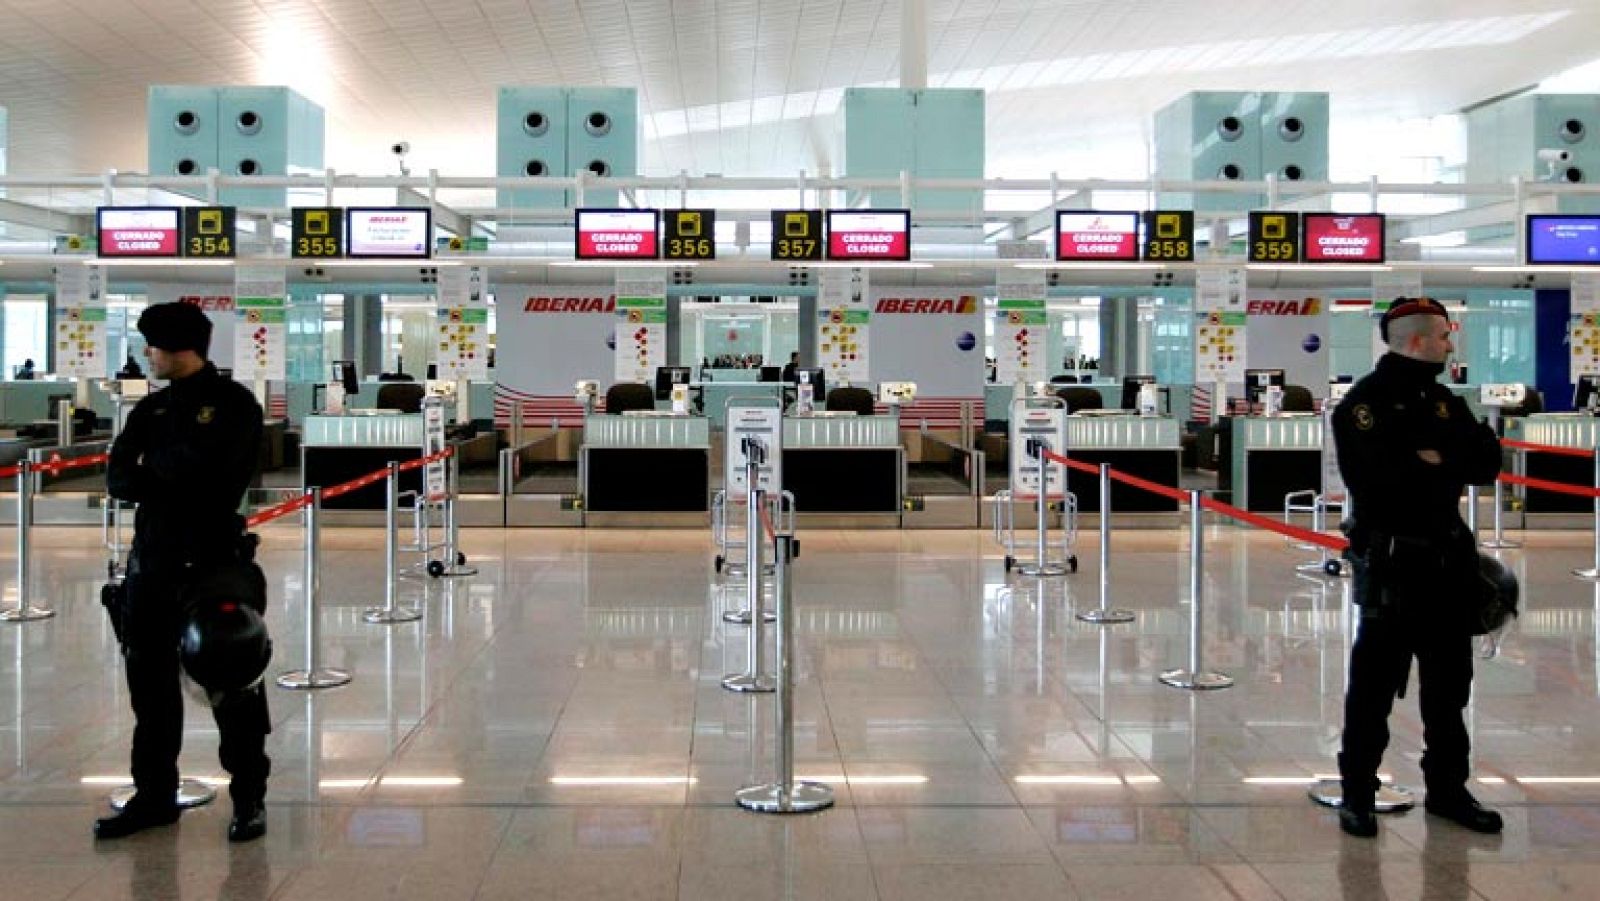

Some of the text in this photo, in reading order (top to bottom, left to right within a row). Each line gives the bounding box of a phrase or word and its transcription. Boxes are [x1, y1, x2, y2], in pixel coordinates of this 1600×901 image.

[592, 233, 642, 242] CERRADO
[842, 233, 893, 242] CERRADO
[1072, 233, 1123, 242] CERRADO
[190, 237, 229, 255] 354
[298, 237, 336, 255] 355
[596, 244, 638, 253] CLOSED
[670, 239, 709, 255] 356
[778, 239, 815, 257] 357
[846, 244, 889, 253] CLOSED
[1076, 244, 1118, 253] CLOSED
[1149, 241, 1188, 257] 358
[1255, 241, 1293, 259] 359
[1322, 247, 1364, 256] CLOSED
[524, 297, 603, 312] IBERIA
[875, 299, 953, 313] IBERIA
[1247, 300, 1299, 315] ERIA
